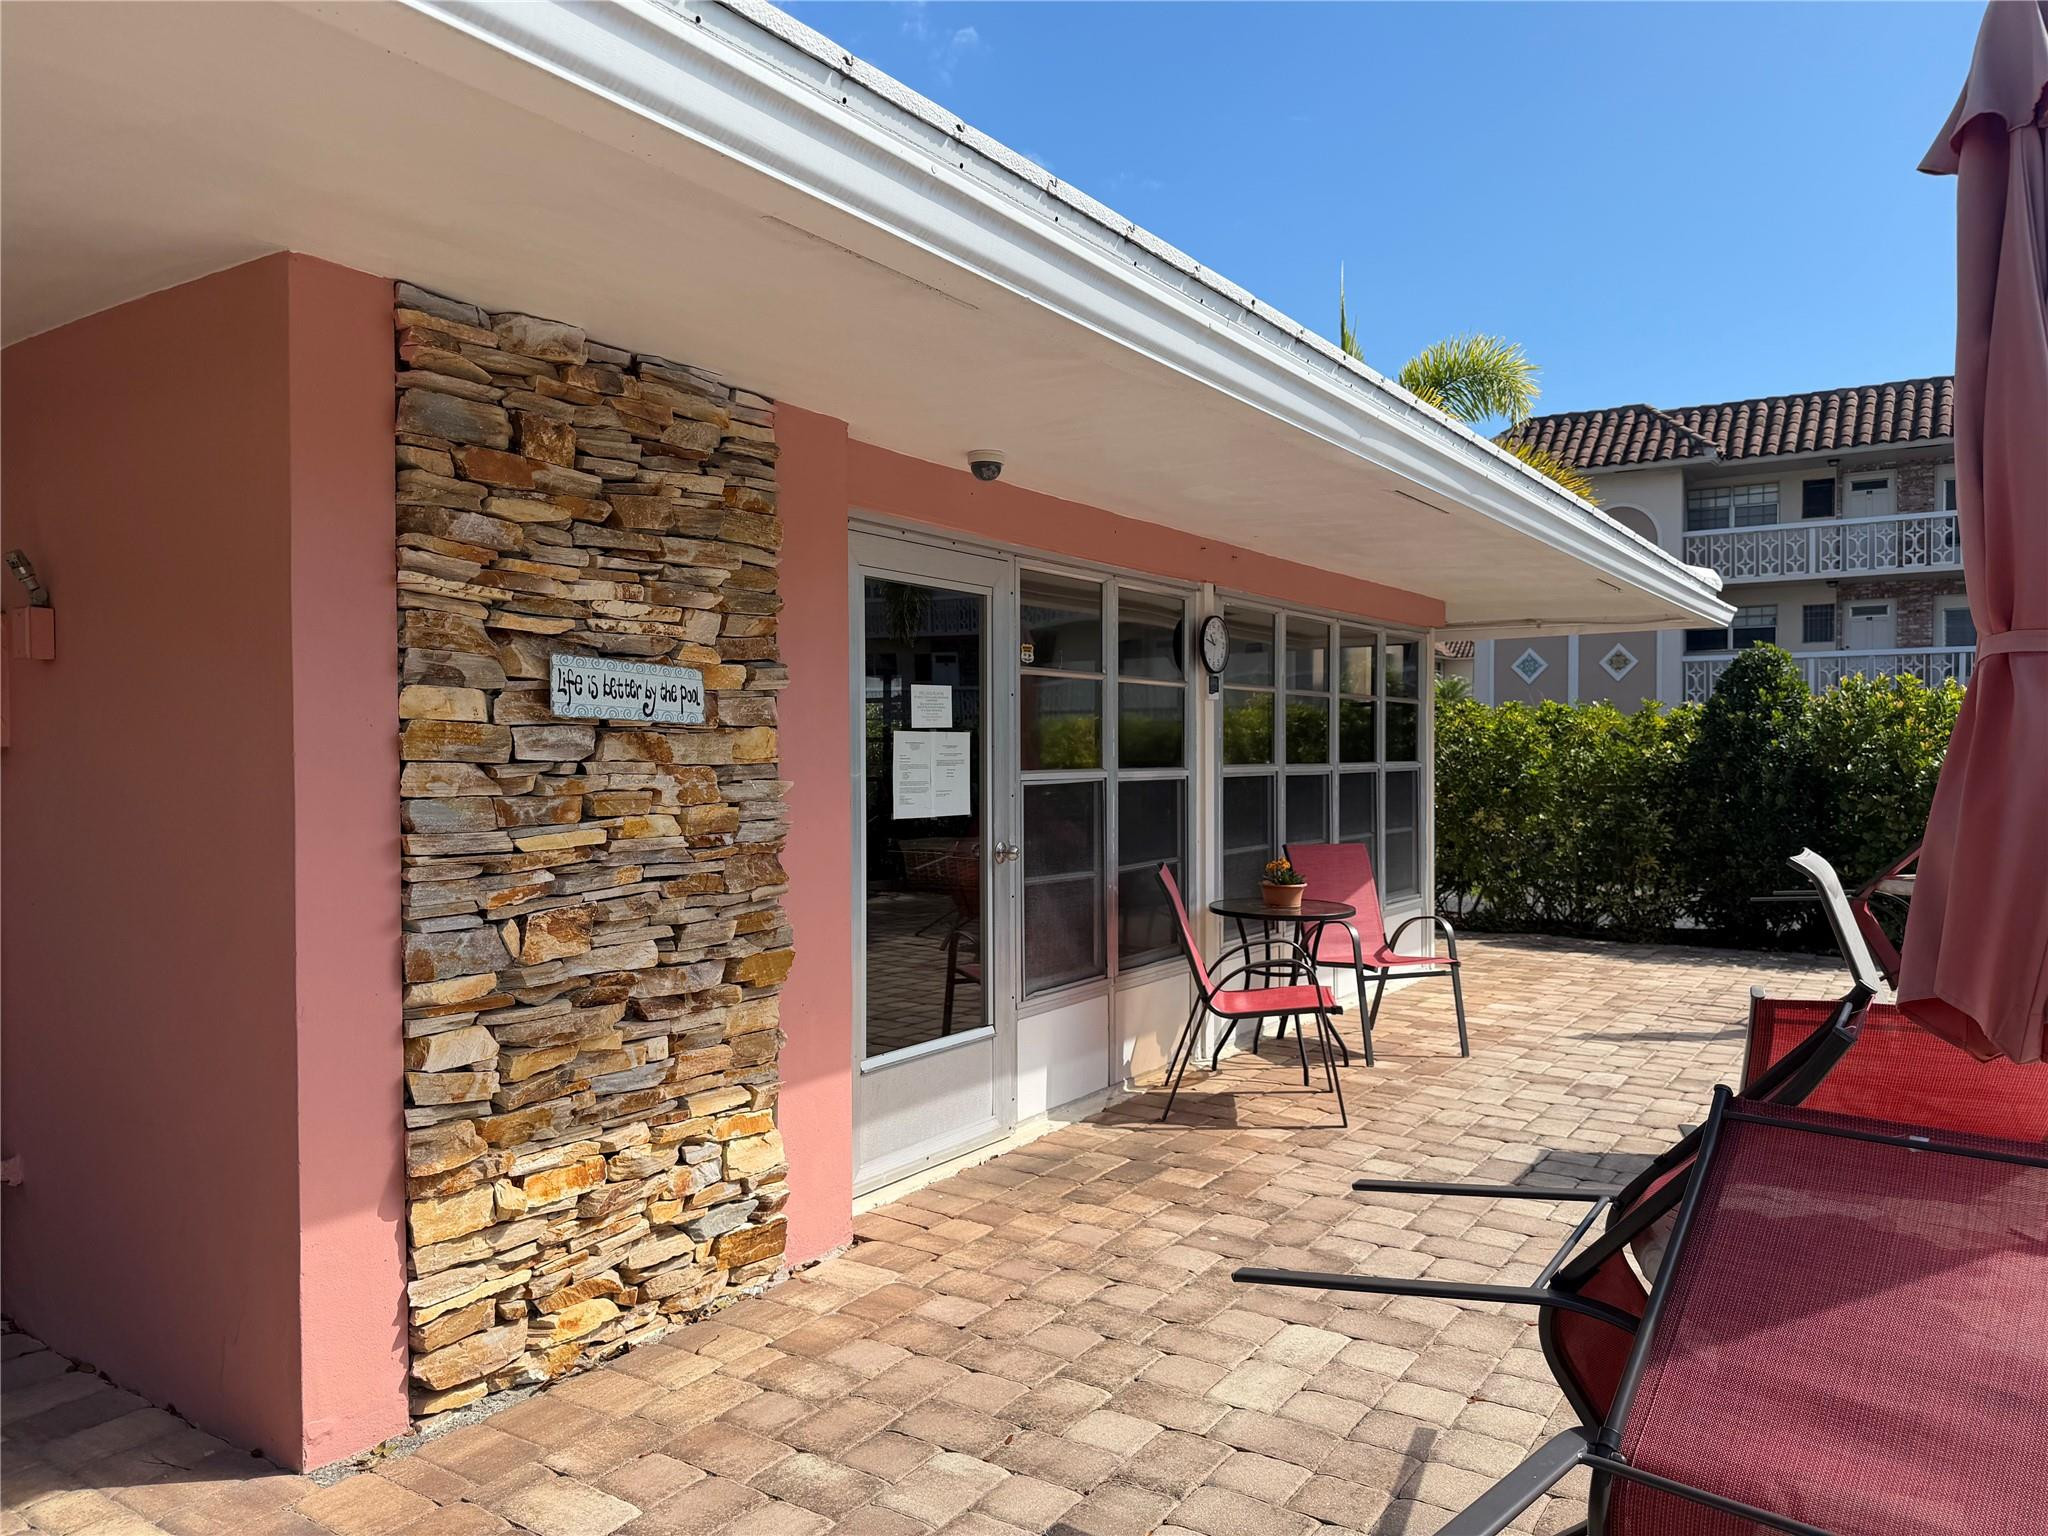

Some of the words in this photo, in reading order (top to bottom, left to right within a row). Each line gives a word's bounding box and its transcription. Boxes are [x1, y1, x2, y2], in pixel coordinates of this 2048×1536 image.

[557, 668, 582, 705] Life
[587, 675, 598, 699] is
[603, 673, 642, 699] better
[642, 679, 656, 716] by
[660, 680, 677, 702] the
[680, 685, 700, 714] pool
